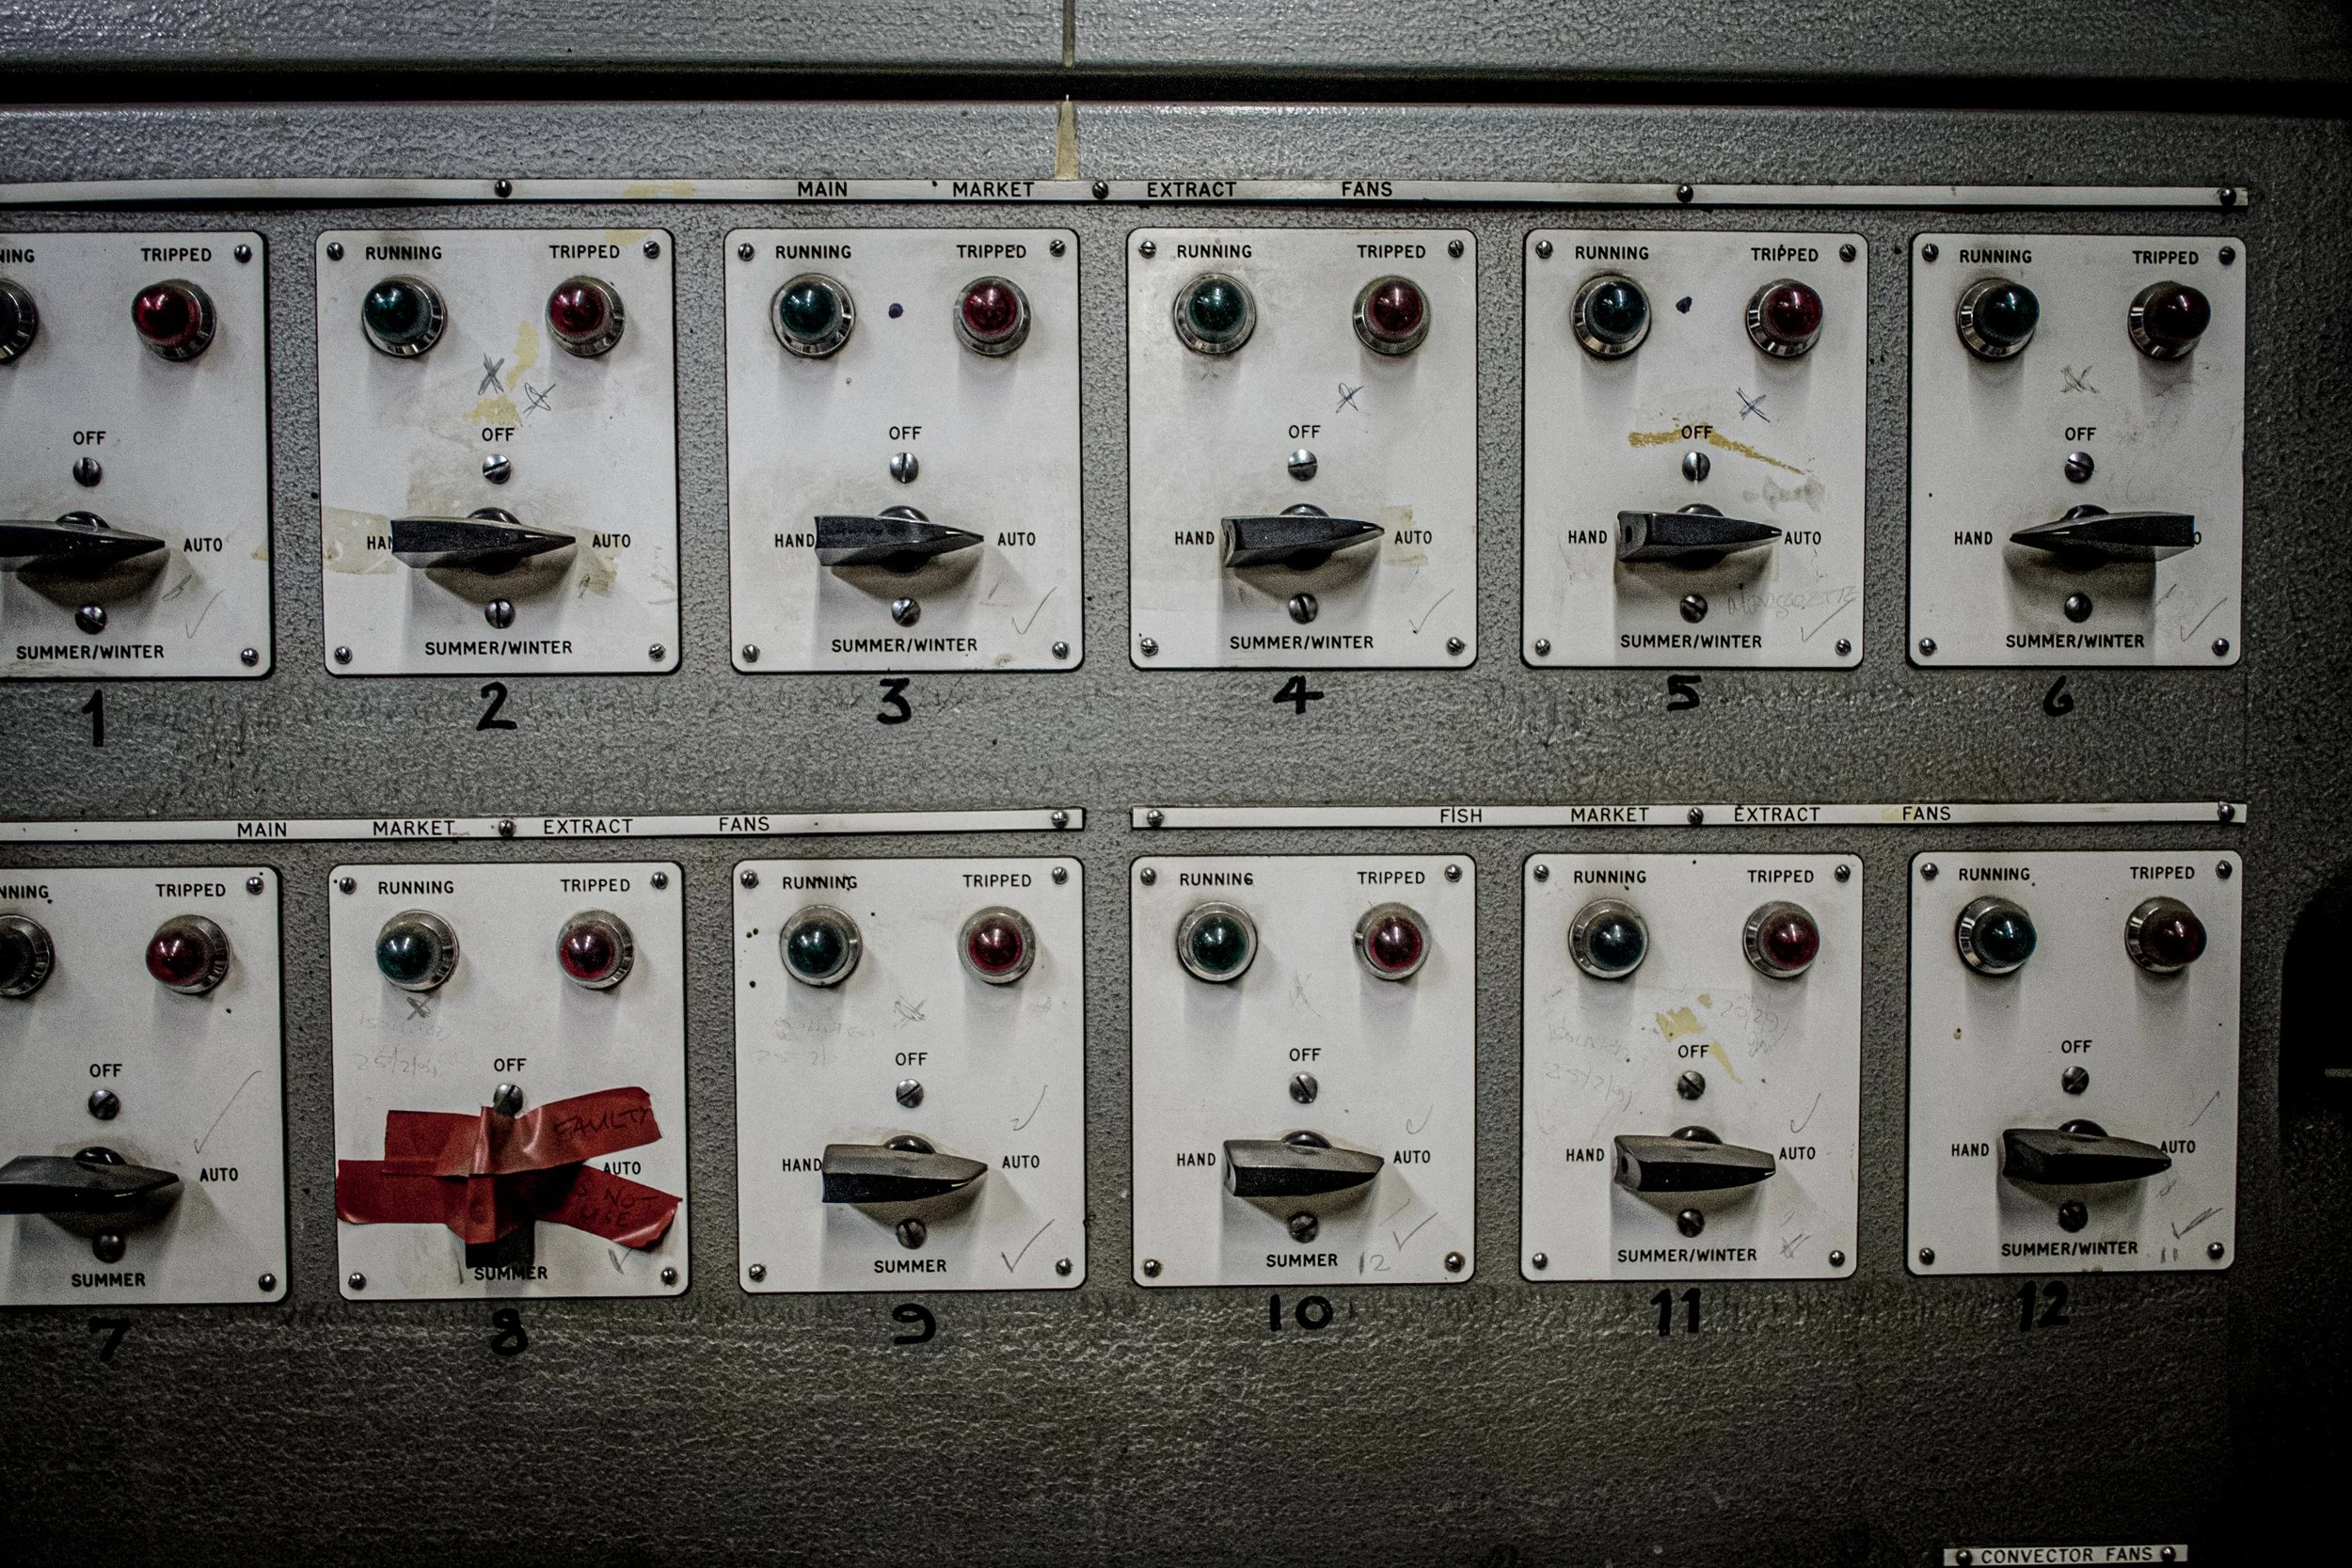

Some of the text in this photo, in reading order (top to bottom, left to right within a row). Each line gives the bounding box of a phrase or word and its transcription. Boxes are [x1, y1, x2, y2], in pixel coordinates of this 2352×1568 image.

[797, 181, 1393, 198] MAIN MARKET EXTRACT FANS
[140, 247, 213, 262] TRIPPED
[365, 245, 442, 261] RUNNING
[548, 245, 620, 260] TRIPPED
[775, 245, 851, 260] RUNNING
[956, 244, 1027, 259] TRIPPED
[1177, 244, 1252, 259] RUNNING
[1357, 244, 1426, 260] TRIPPED
[1575, 245, 1649, 261] RUNNING
[1751, 246, 1819, 262] TRIPPED
[1959, 248, 2032, 264] RUNNING
[2132, 250, 2200, 265] TRIPPED
[72, 430, 106, 446] OFF
[481, 427, 516, 442] OFF
[888, 425, 922, 441] OFF
[1288, 424, 1321, 439] OFF
[1680, 424, 1713, 440] OFF
[2064, 426, 2097, 441] OFF
[183, 537, 223, 553] AUTO
[592, 533, 631, 548] AUTO
[774, 532, 816, 547] HAND
[997, 531, 1036, 546] AUTO
[1174, 531, 1216, 546] HAND
[1393, 530, 1433, 546] AUTO
[1567, 530, 1608, 545] HAND
[1784, 531, 1822, 546] AUTO
[1954, 531, 1994, 546] HAND
[424, 640, 572, 656] SUMMER/WINTER
[831, 638, 977, 653] SUMMER/WINTER
[1230, 635, 1374, 650] SUMMER/WINTER
[1620, 634, 1762, 649] SUMMER/WINTER
[2006, 633, 2145, 649] SUMMER/WINTER
[16, 644, 165, 660] SUMMER/WINTER
[877, 677, 912, 723] 3
[1273, 675, 1324, 713] 4
[1667, 675, 1701, 711] 5
[2043, 675, 2074, 716] 6
[477, 682, 516, 731] 2
[82, 689, 104, 747] 1
[1440, 805, 1951, 823] FISH MARKET EXTRACT FANS
[237, 816, 771, 838] MAIN MARKET EXTRACT FANS
[1180, 872, 1254, 887] RUNNING
[1357, 870, 1426, 885] TRIPPED
[1573, 870, 1646, 884] RUNNING
[1747, 869, 1815, 883] TRIPPED
[1959, 867, 2030, 881] RUNNING
[2129, 865, 2196, 880] TRIPPED
[378, 879, 454, 895] RUNNING
[560, 878, 631, 893] TRIPPED
[782, 875, 858, 892] RUNNING
[962, 873, 1032, 888] TRIPPED
[155, 882, 227, 897] TRIPPED
[1677, 1044, 1709, 1059] OFF
[2060, 1039, 2092, 1054] OFF
[895, 1052, 928, 1067] OFF
[1289, 1047, 1322, 1062] OFF
[88, 1063, 123, 1078] OFF
[493, 1057, 527, 1072] OFF
[1778, 1146, 1817, 1161] AUTO
[1951, 1142, 1990, 1157] HAND
[2159, 1139, 2196, 1154] AUTO
[1001, 1154, 1041, 1169] AUTO
[1176, 1152, 1216, 1166] HAND
[1392, 1149, 1431, 1164] AUTO
[1565, 1148, 1605, 1162] HAND
[603, 1161, 641, 1176] AUTO
[782, 1157, 823, 1173] HAND
[199, 1167, 239, 1182] AUTO
[1617, 1247, 1757, 1263] SUMMER/WINTER
[2001, 1240, 2138, 1258] SUMMER/WINTER
[874, 1259, 947, 1274] SUMMER
[1265, 1253, 1338, 1268] SUMMER
[71, 1272, 146, 1288] SUMMER
[474, 1265, 548, 1281] SUMMER
[1270, 1293, 1333, 1331] 10
[1650, 1288, 1701, 1337] 11
[2016, 1281, 2070, 1333] 12
[490, 1307, 529, 1355] 8
[892, 1302, 936, 1345] 9
[87, 1317, 133, 1363] 7
[1980, 1546, 2153, 1564] CONVECTOR FANS
